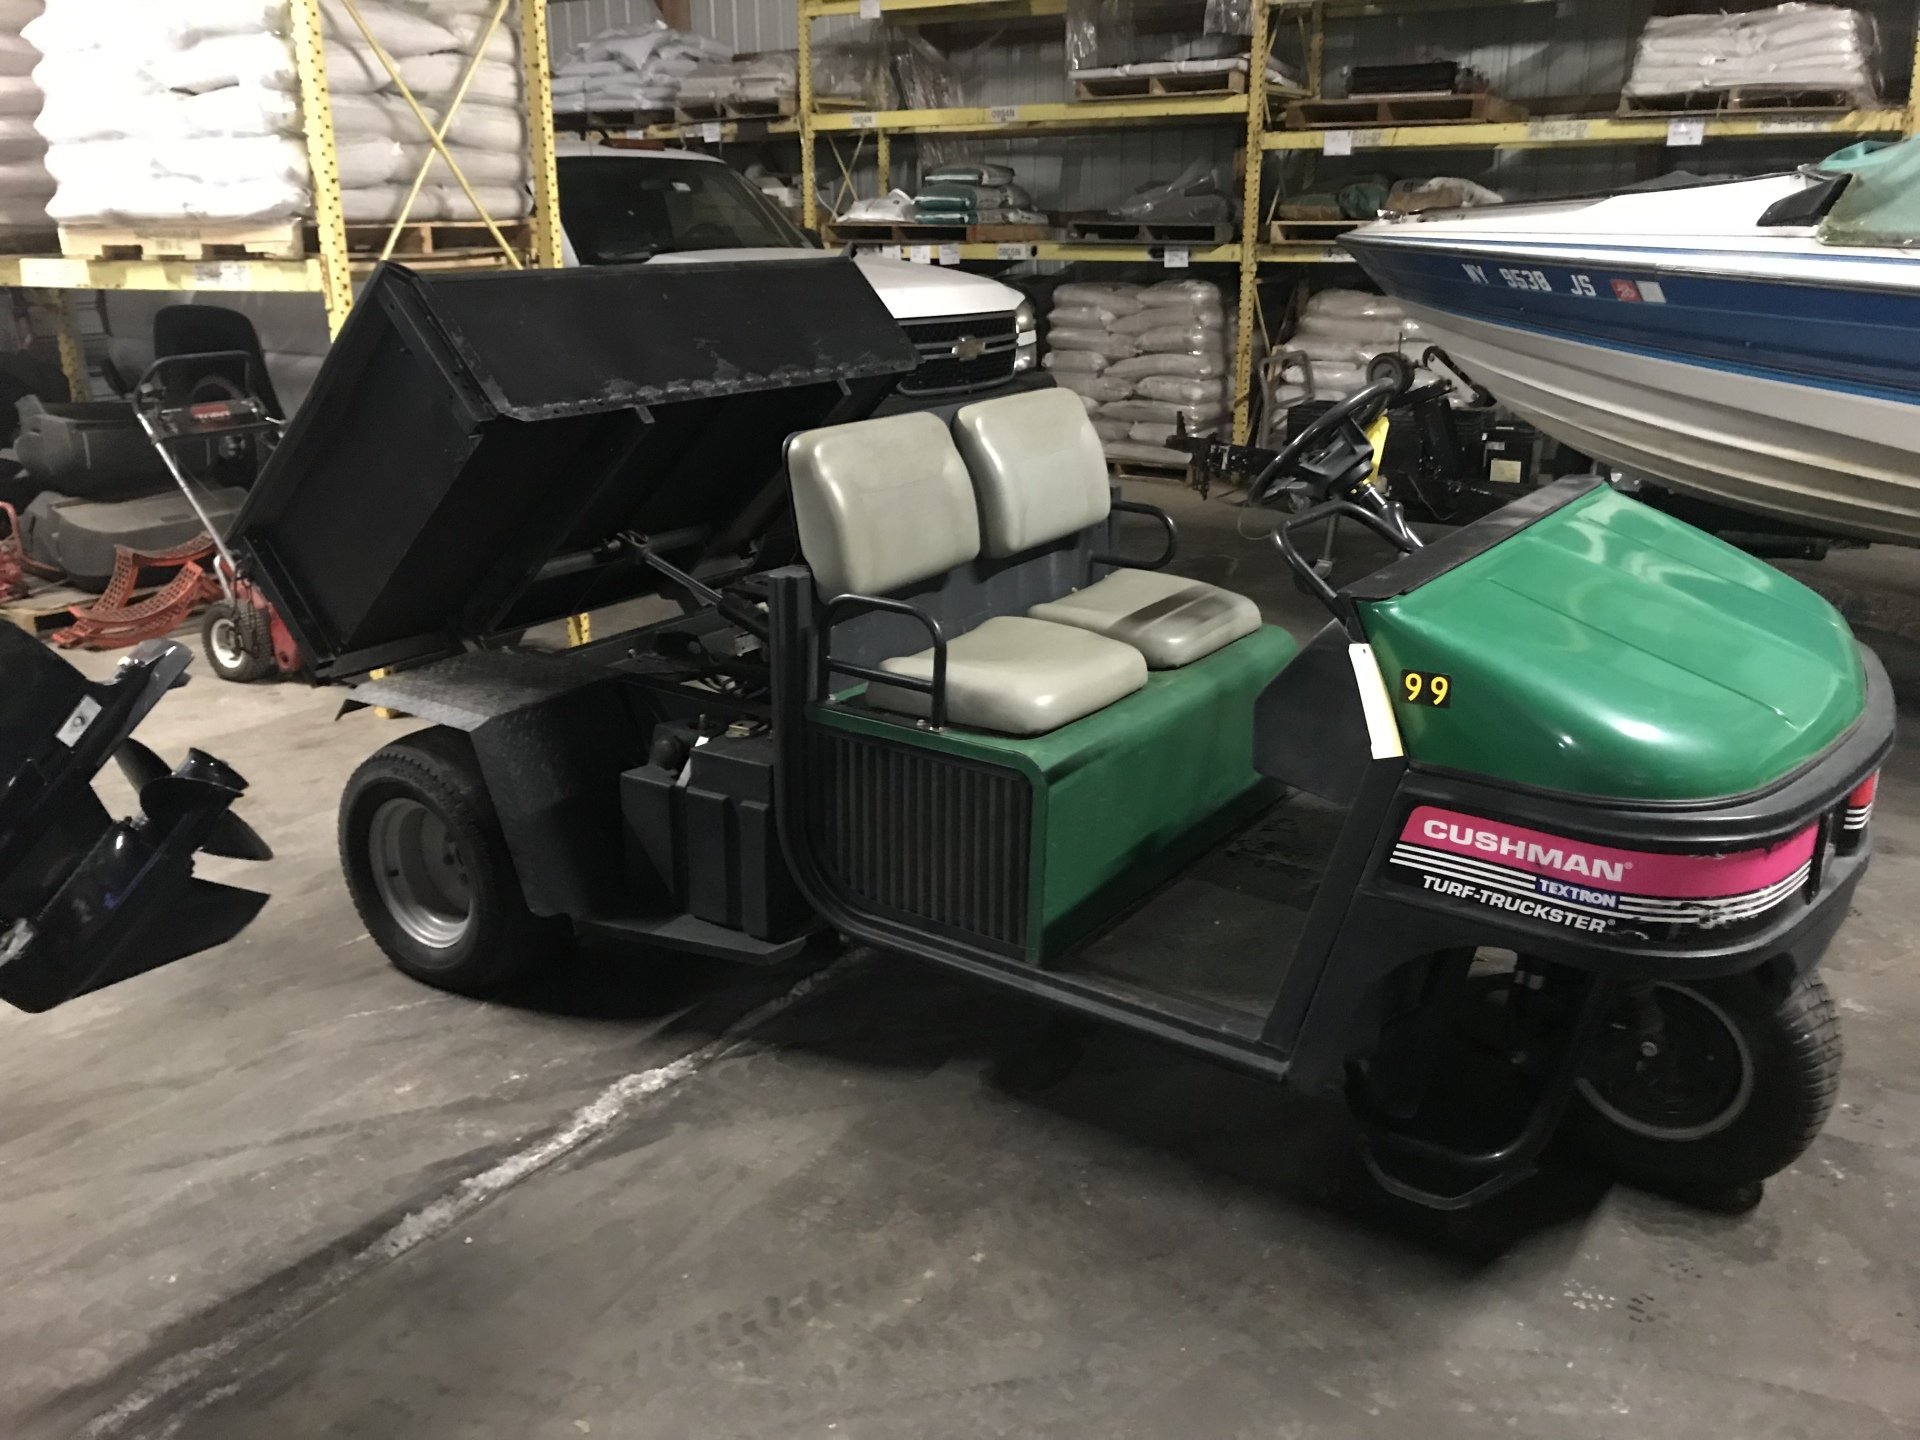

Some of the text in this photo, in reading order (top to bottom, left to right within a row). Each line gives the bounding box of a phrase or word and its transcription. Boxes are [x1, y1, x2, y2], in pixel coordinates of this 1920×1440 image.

[1461, 263, 1489, 285] NY
[1570, 274, 1597, 297] JS
[1405, 672, 1448, 705] 99
[1423, 820, 1623, 881] CUSHMAN
[1423, 875, 1606, 932] TURF-TRUCKSTER
[1539, 878, 1618, 908] TEXTRON
